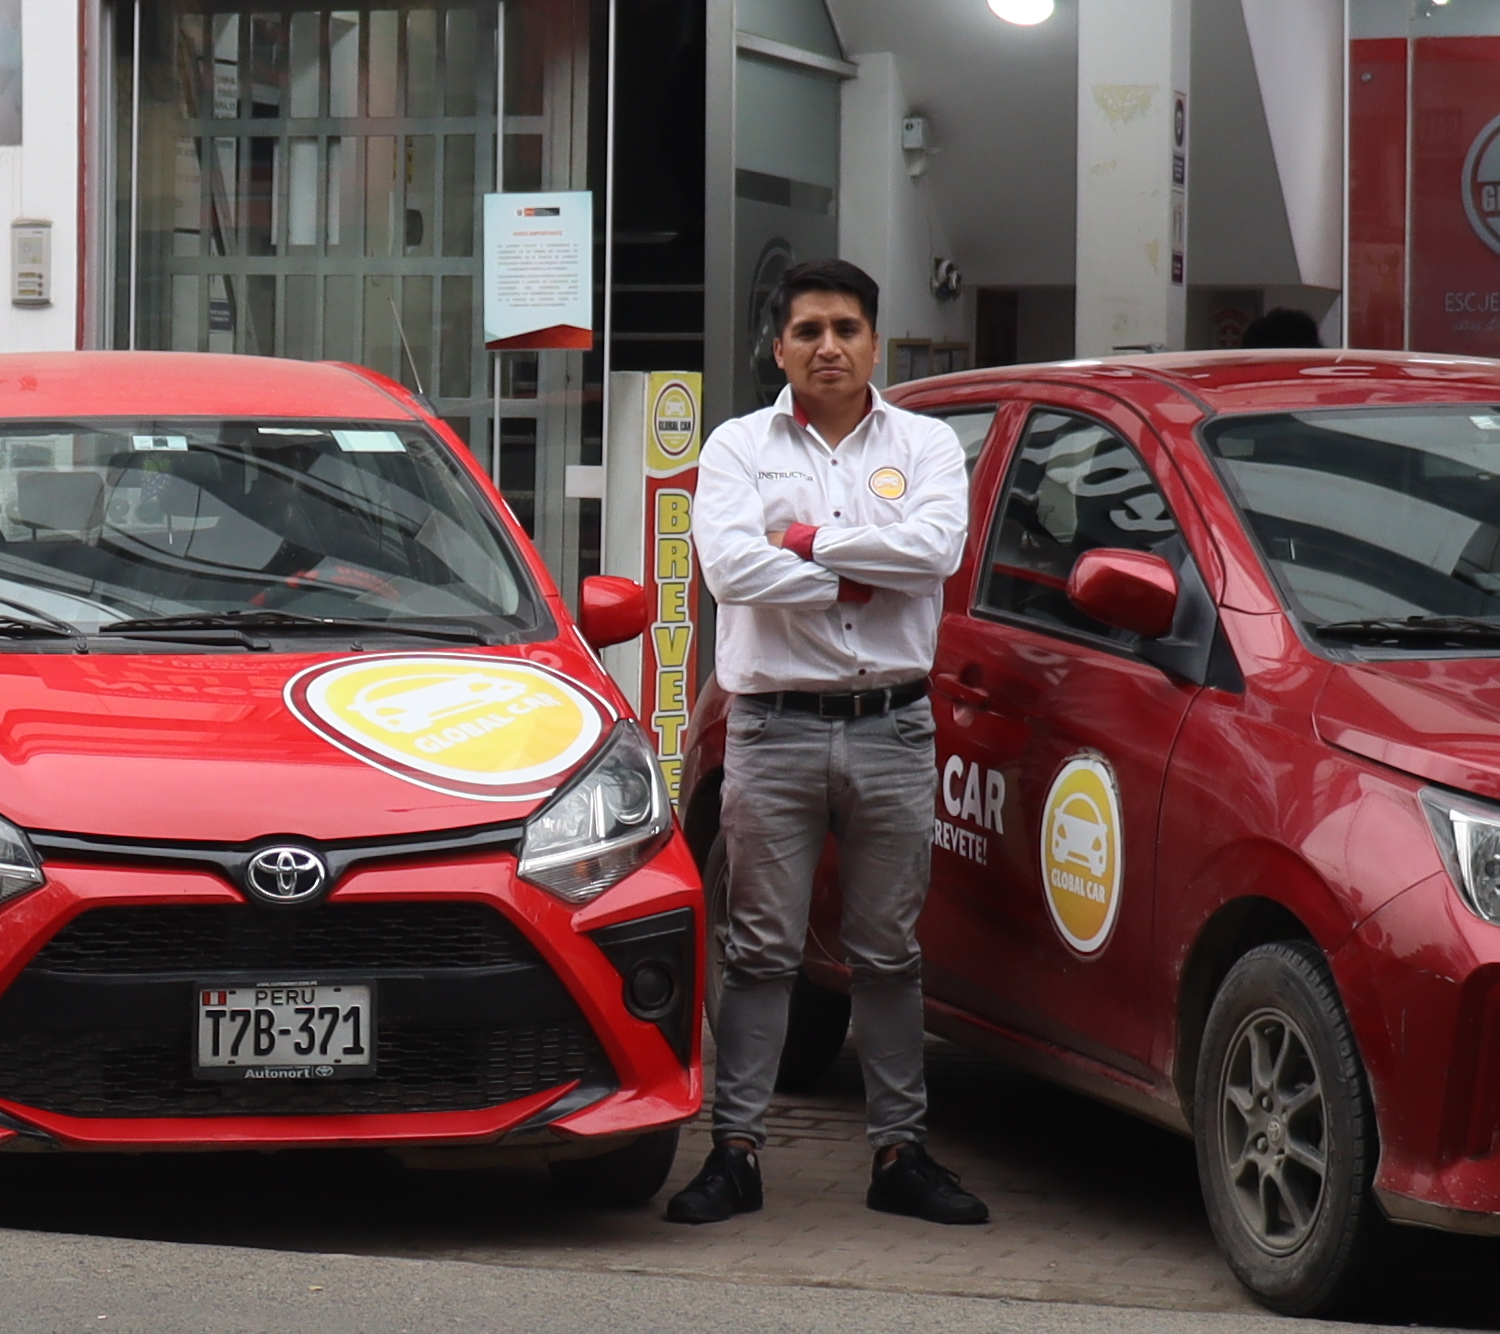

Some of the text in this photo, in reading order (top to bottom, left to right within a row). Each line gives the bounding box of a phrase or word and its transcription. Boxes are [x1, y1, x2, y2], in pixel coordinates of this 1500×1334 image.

[658, 420, 692, 432] GLOBAL CAR
[413, 692, 563, 755] GLOBAL CAR
[942, 753, 1006, 836] CAR
[931, 818, 988, 867] REVETE!
[1050, 867, 1106, 904] GLOBAL CAR
[255, 989, 316, 1006] PERU
[205, 1005, 365, 1057] T7B-371
[244, 1067, 311, 1079] Autonort
